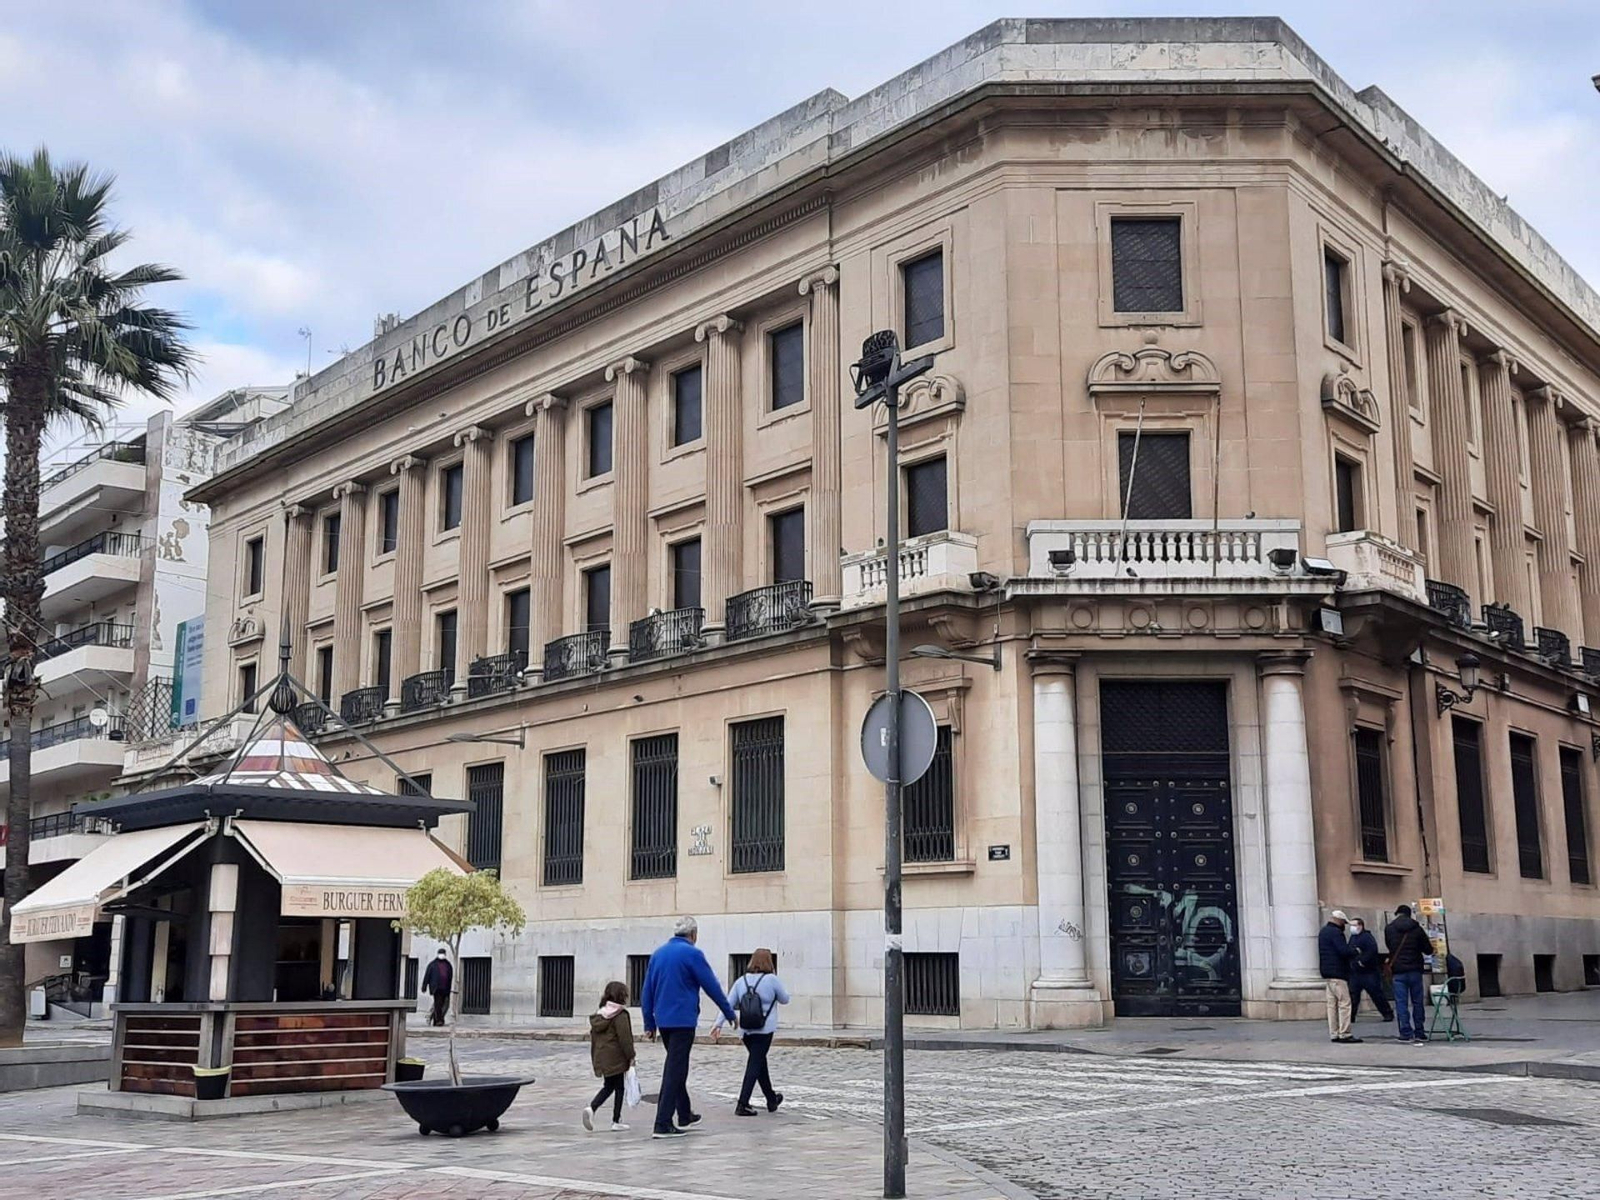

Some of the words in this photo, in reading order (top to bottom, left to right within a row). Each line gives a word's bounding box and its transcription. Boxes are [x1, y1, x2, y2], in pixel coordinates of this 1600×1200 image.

[373, 313, 471, 391] BANCO
[487, 303, 511, 332] DE
[323, 891, 374, 911] BURGUER
